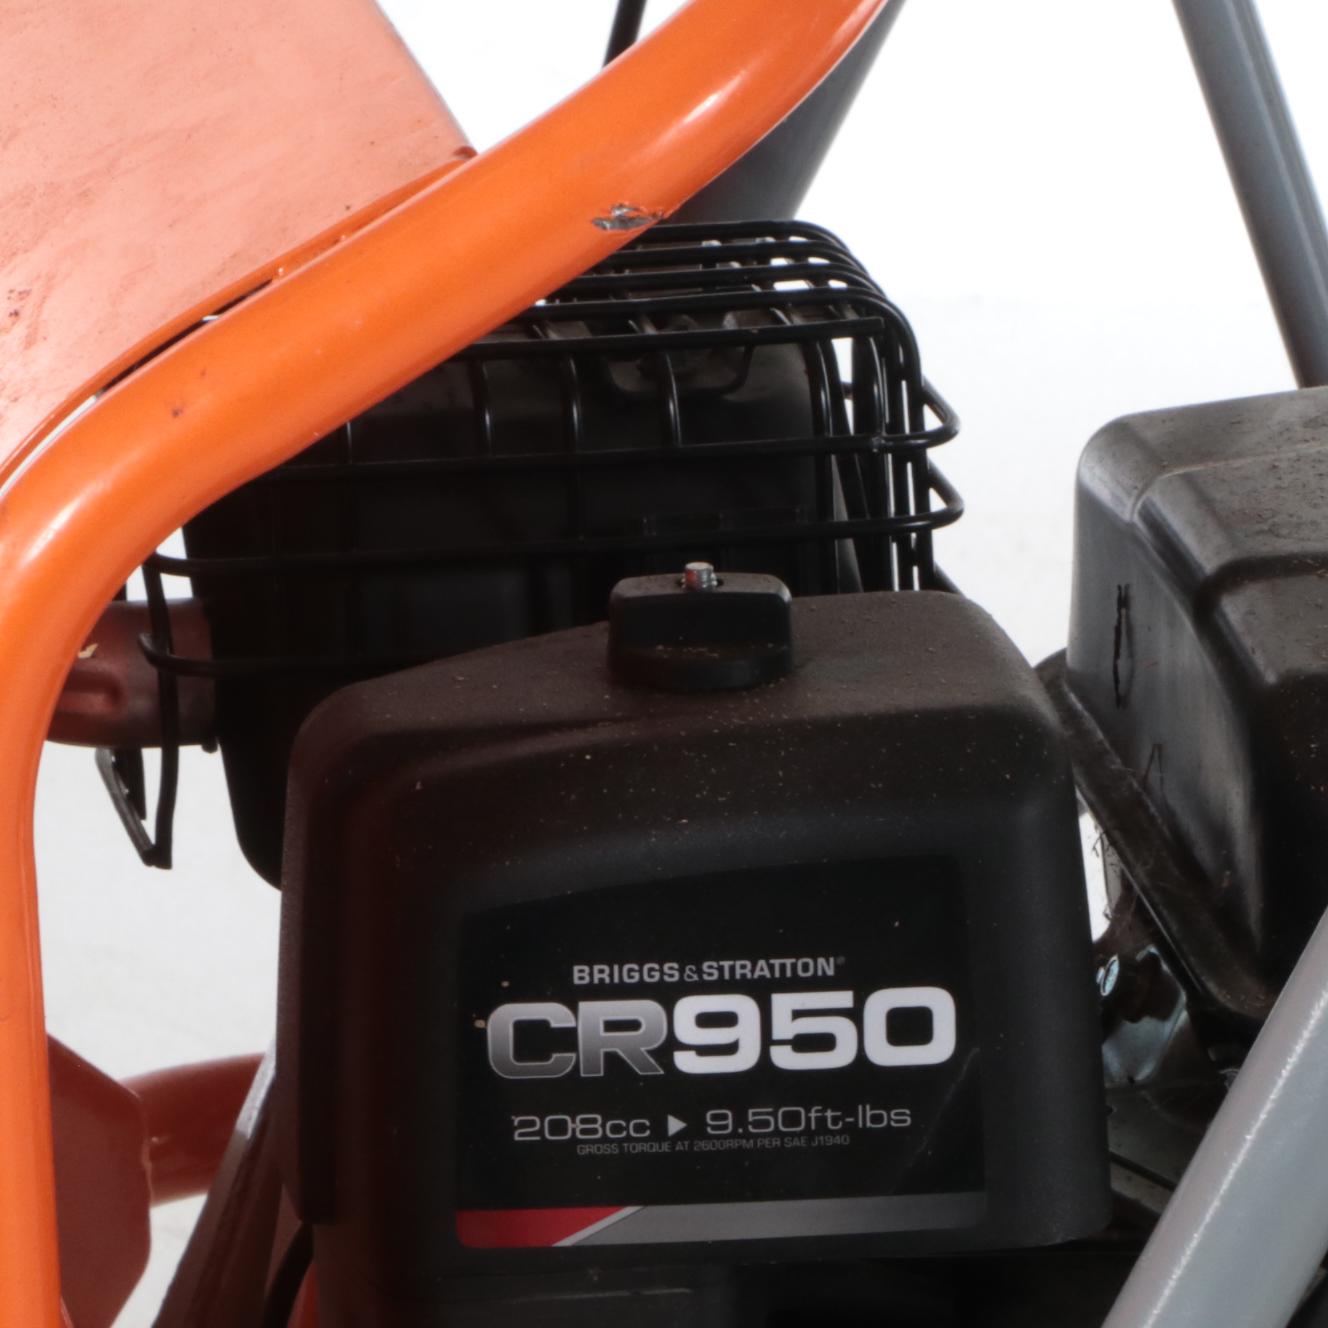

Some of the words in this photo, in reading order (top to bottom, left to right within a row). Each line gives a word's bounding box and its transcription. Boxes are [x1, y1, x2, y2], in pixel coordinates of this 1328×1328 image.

[486, 985, 958, 1080] CR950
[513, 1113, 651, 1141] 208cc
[705, 1103, 912, 1135] 9.50ft-lbs
[576, 1143, 620, 1156] GROSS
[623, 1142, 671, 1153] TORQUE
[675, 1140, 690, 1151] AT
[693, 1138, 753, 1151] 2600RPM
[756, 1137, 781, 1149] PER
[783, 1136, 808, 1148] SAE
[811, 1134, 850, 1147] J1940
